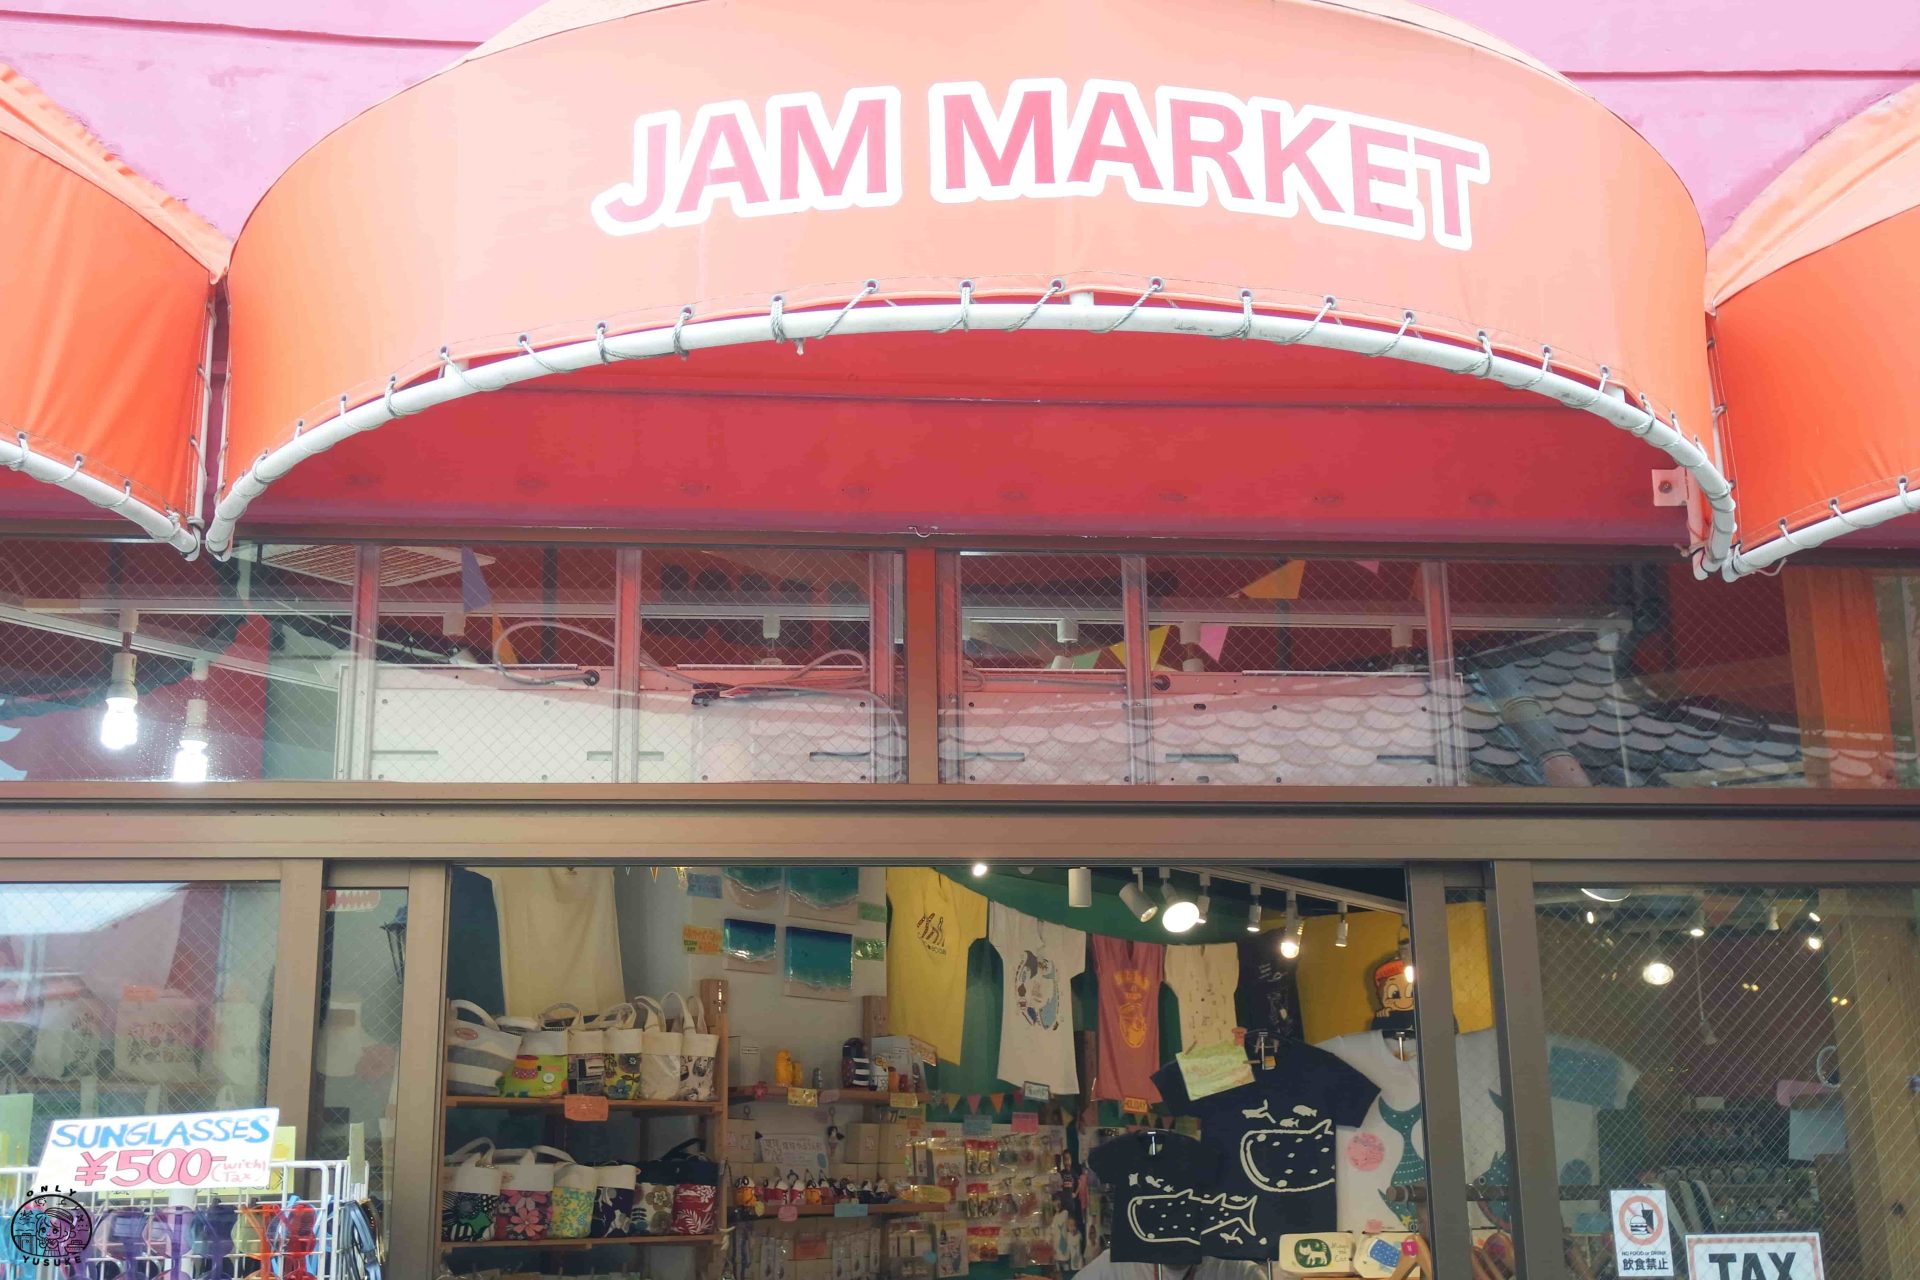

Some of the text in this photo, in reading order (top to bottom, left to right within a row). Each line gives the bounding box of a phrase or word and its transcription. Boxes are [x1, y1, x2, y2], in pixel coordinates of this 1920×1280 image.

[598, 82, 1486, 244] JAM MARKET
[51, 1115, 271, 1148] SUNGLASSES
[1622, 1258, 1669, 1271] 飲食禁止
[1708, 1252, 1797, 1280] TAX
